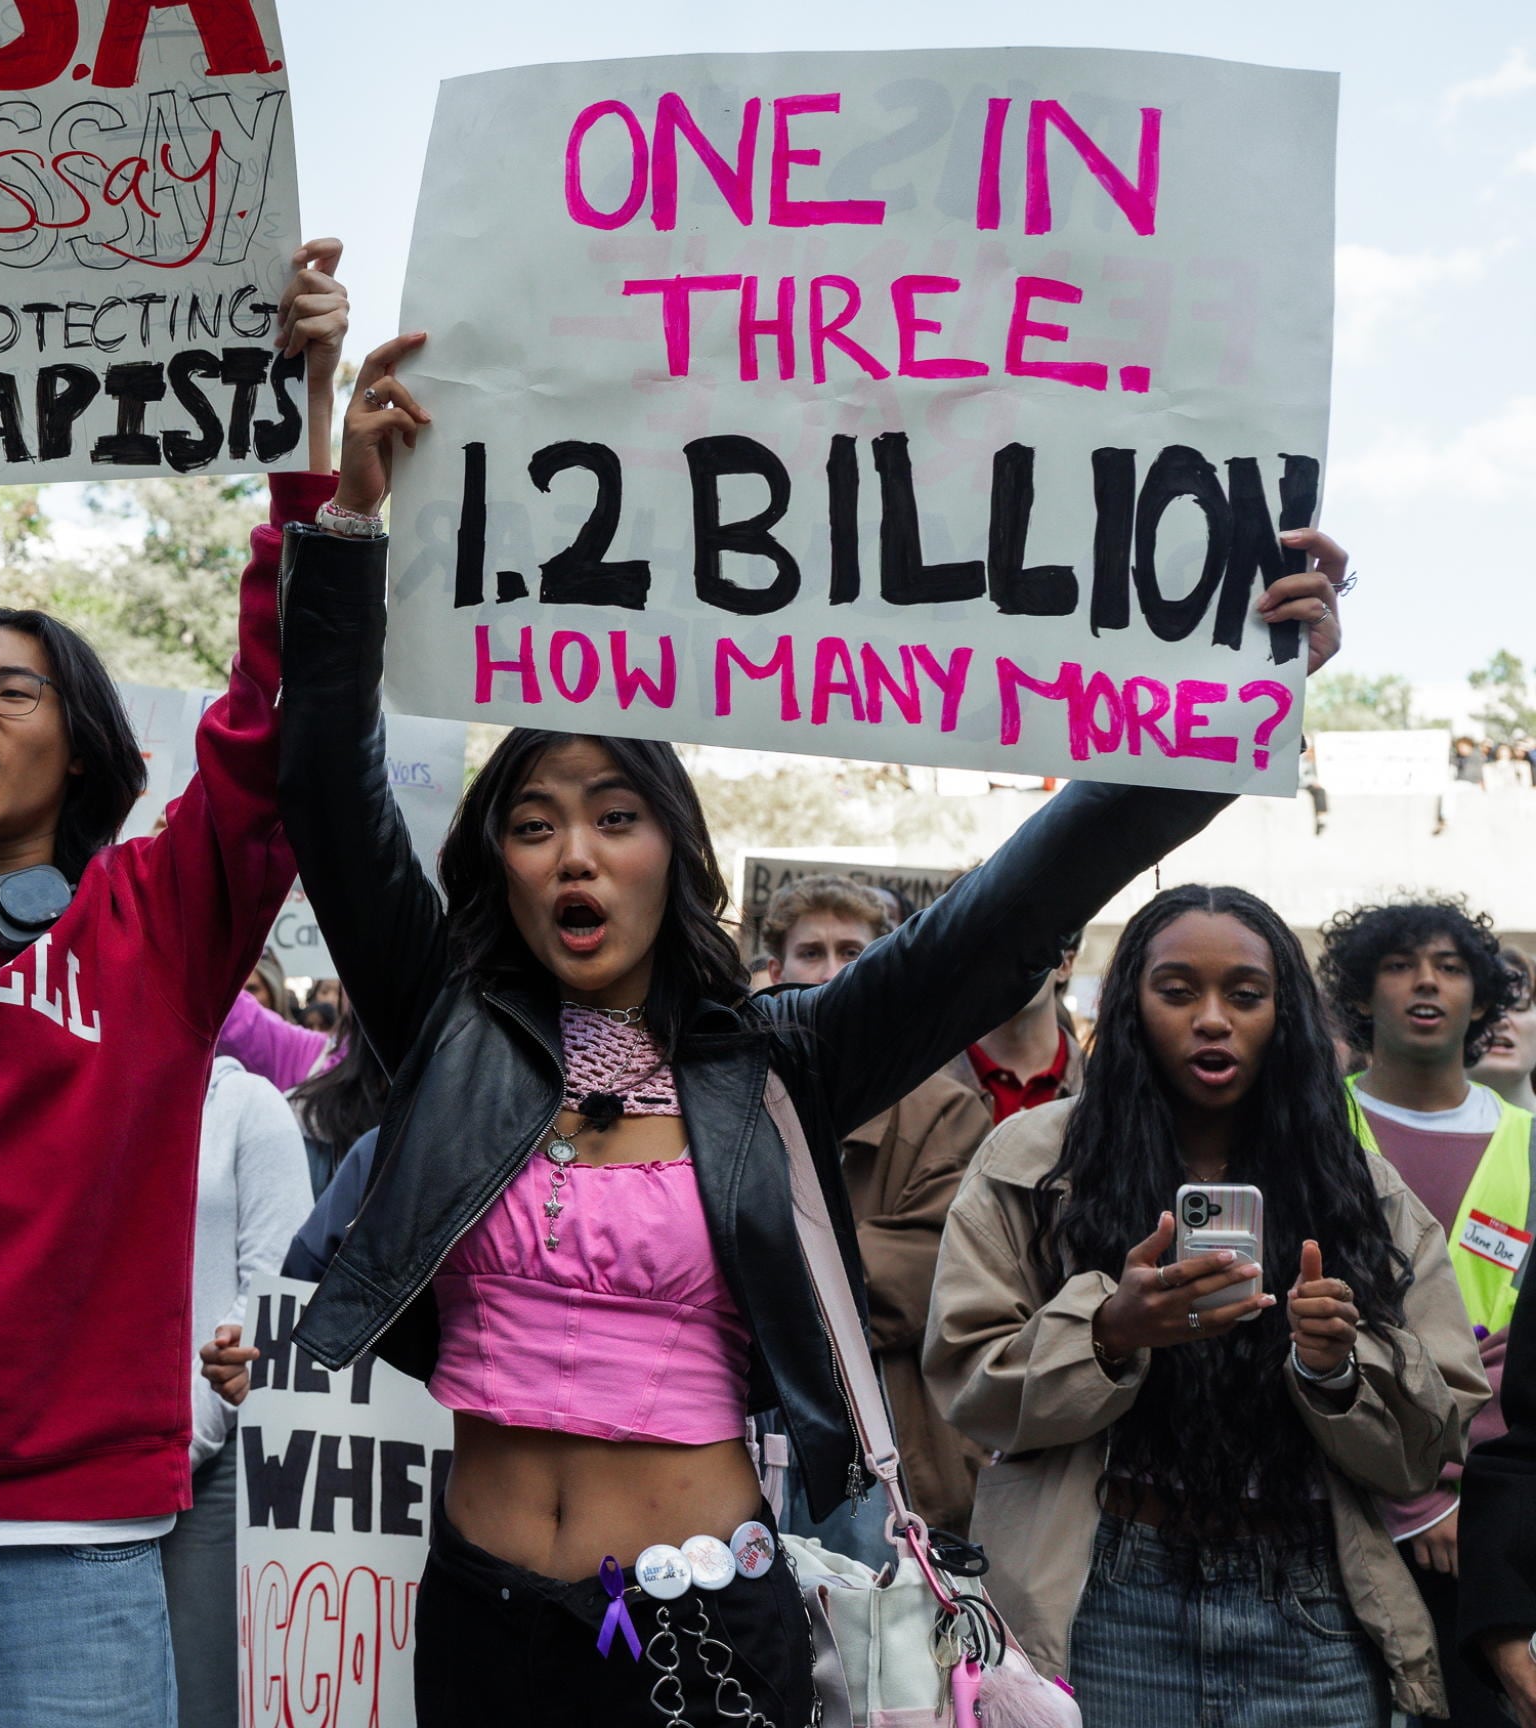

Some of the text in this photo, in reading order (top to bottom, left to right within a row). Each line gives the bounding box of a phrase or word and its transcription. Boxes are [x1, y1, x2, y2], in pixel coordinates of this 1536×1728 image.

[565, 92, 886, 232] ONE
[977, 97, 1161, 236] IN
[622, 272, 1152, 393] THREE.
[453, 434, 652, 609] 1.2
[683, 432, 1321, 666] BILLION
[473, 624, 1294, 770] HOW MANY MORE?
[1464, 1222, 1516, 1262] Jane Doe
